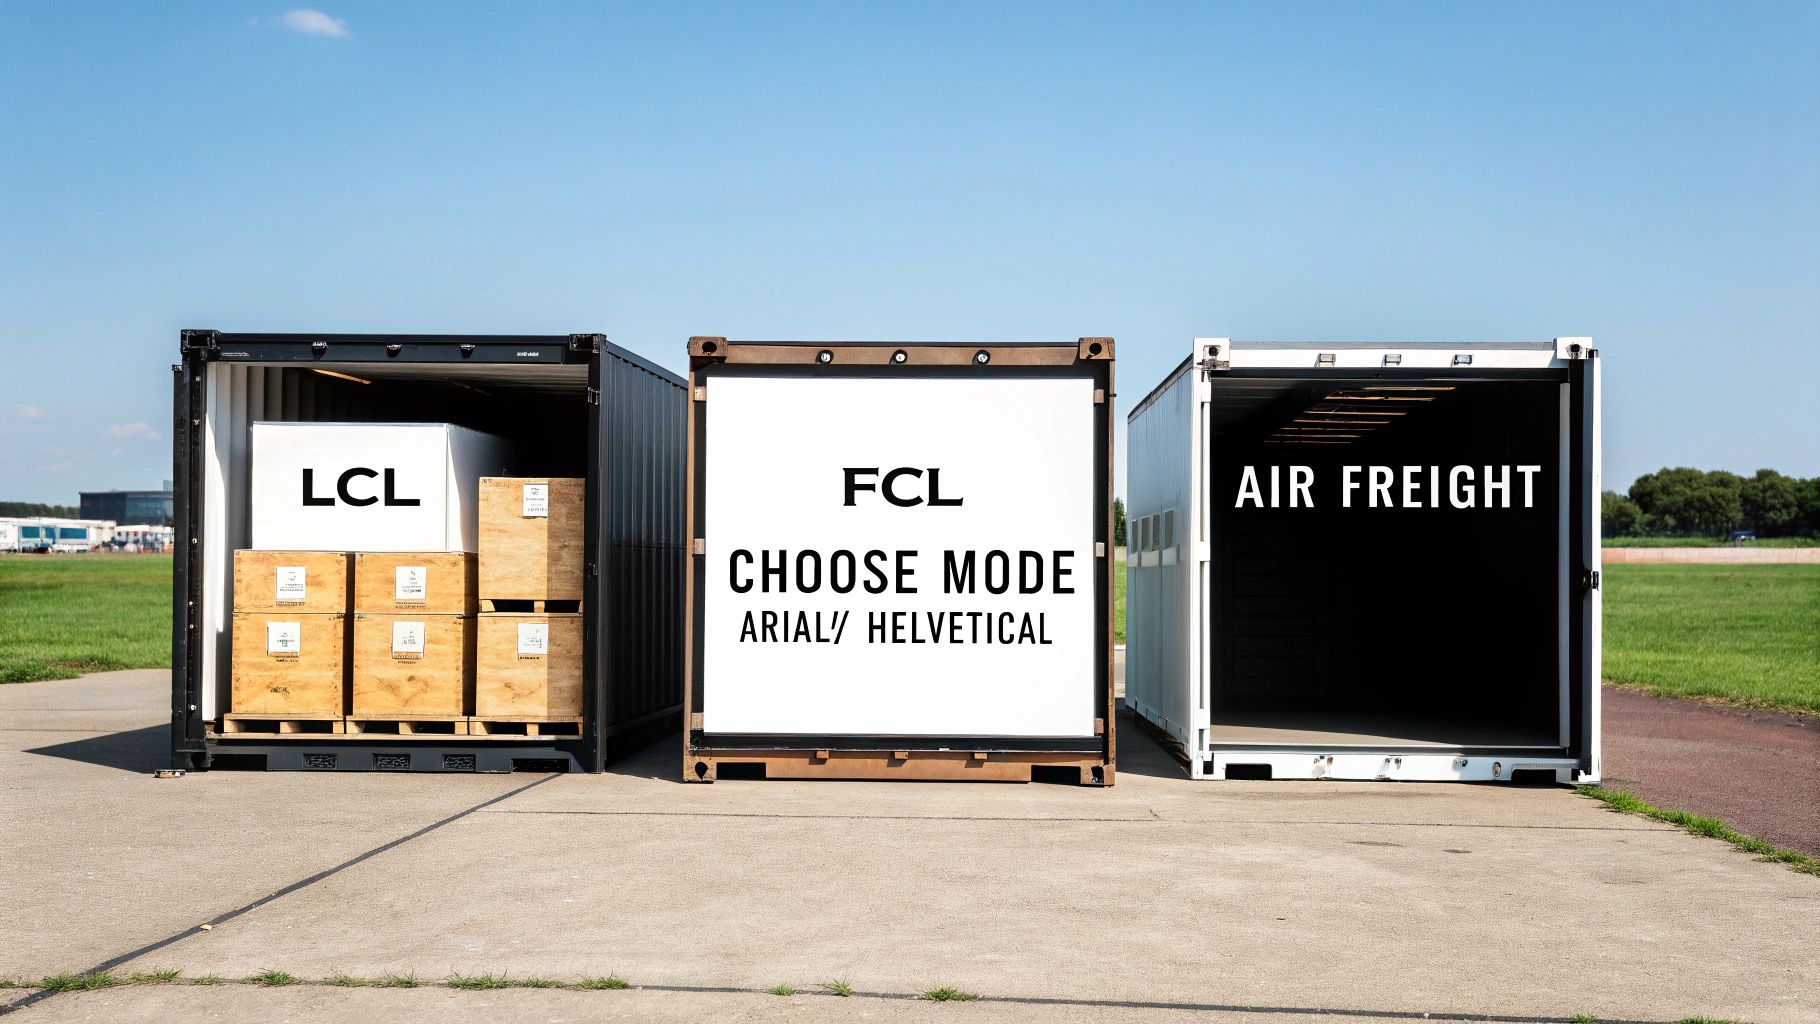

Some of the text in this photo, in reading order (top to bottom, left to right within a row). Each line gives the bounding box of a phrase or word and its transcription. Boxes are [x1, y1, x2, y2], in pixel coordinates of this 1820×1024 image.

[303, 468, 420, 507] LCL
[843, 467, 963, 507] FCL
[1234, 465, 1541, 508] AIR FREIGHT
[729, 549, 1075, 594] CHOOSE MODE
[868, 611, 1053, 644] HELVETICAL
